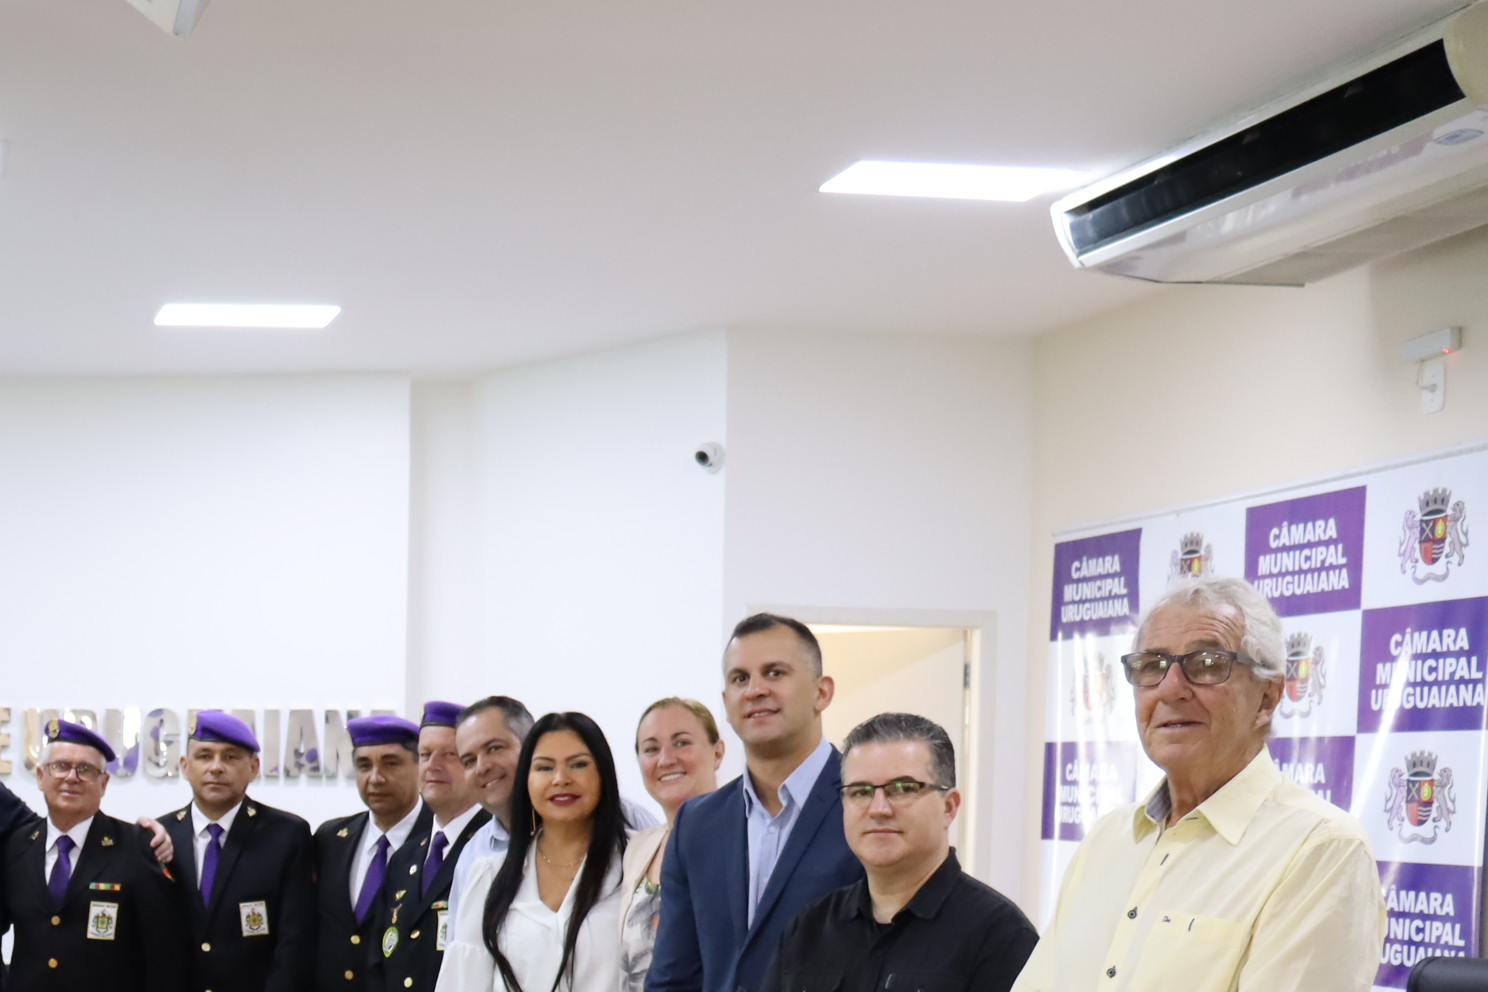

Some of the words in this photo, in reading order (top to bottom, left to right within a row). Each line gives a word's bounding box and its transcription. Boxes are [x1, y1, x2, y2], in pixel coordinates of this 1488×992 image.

[1269, 518, 1338, 549] CÂMARA
[1071, 554, 1121, 579] CÂMARA
[1257, 543, 1347, 576] MUNICIPAL
[1063, 576, 1128, 602] MUNICIPAL
[1061, 597, 1130, 623] URUGUAIANA
[1390, 627, 1470, 656] CÂMARA
[1376, 656, 1484, 685] MNICIPAL
[1371, 683, 1485, 711] UGUAIANA
[1274, 758, 1326, 784] MARA
[1387, 885, 1455, 916] ÂMARA
[1388, 918, 1465, 947] NICIPAL
